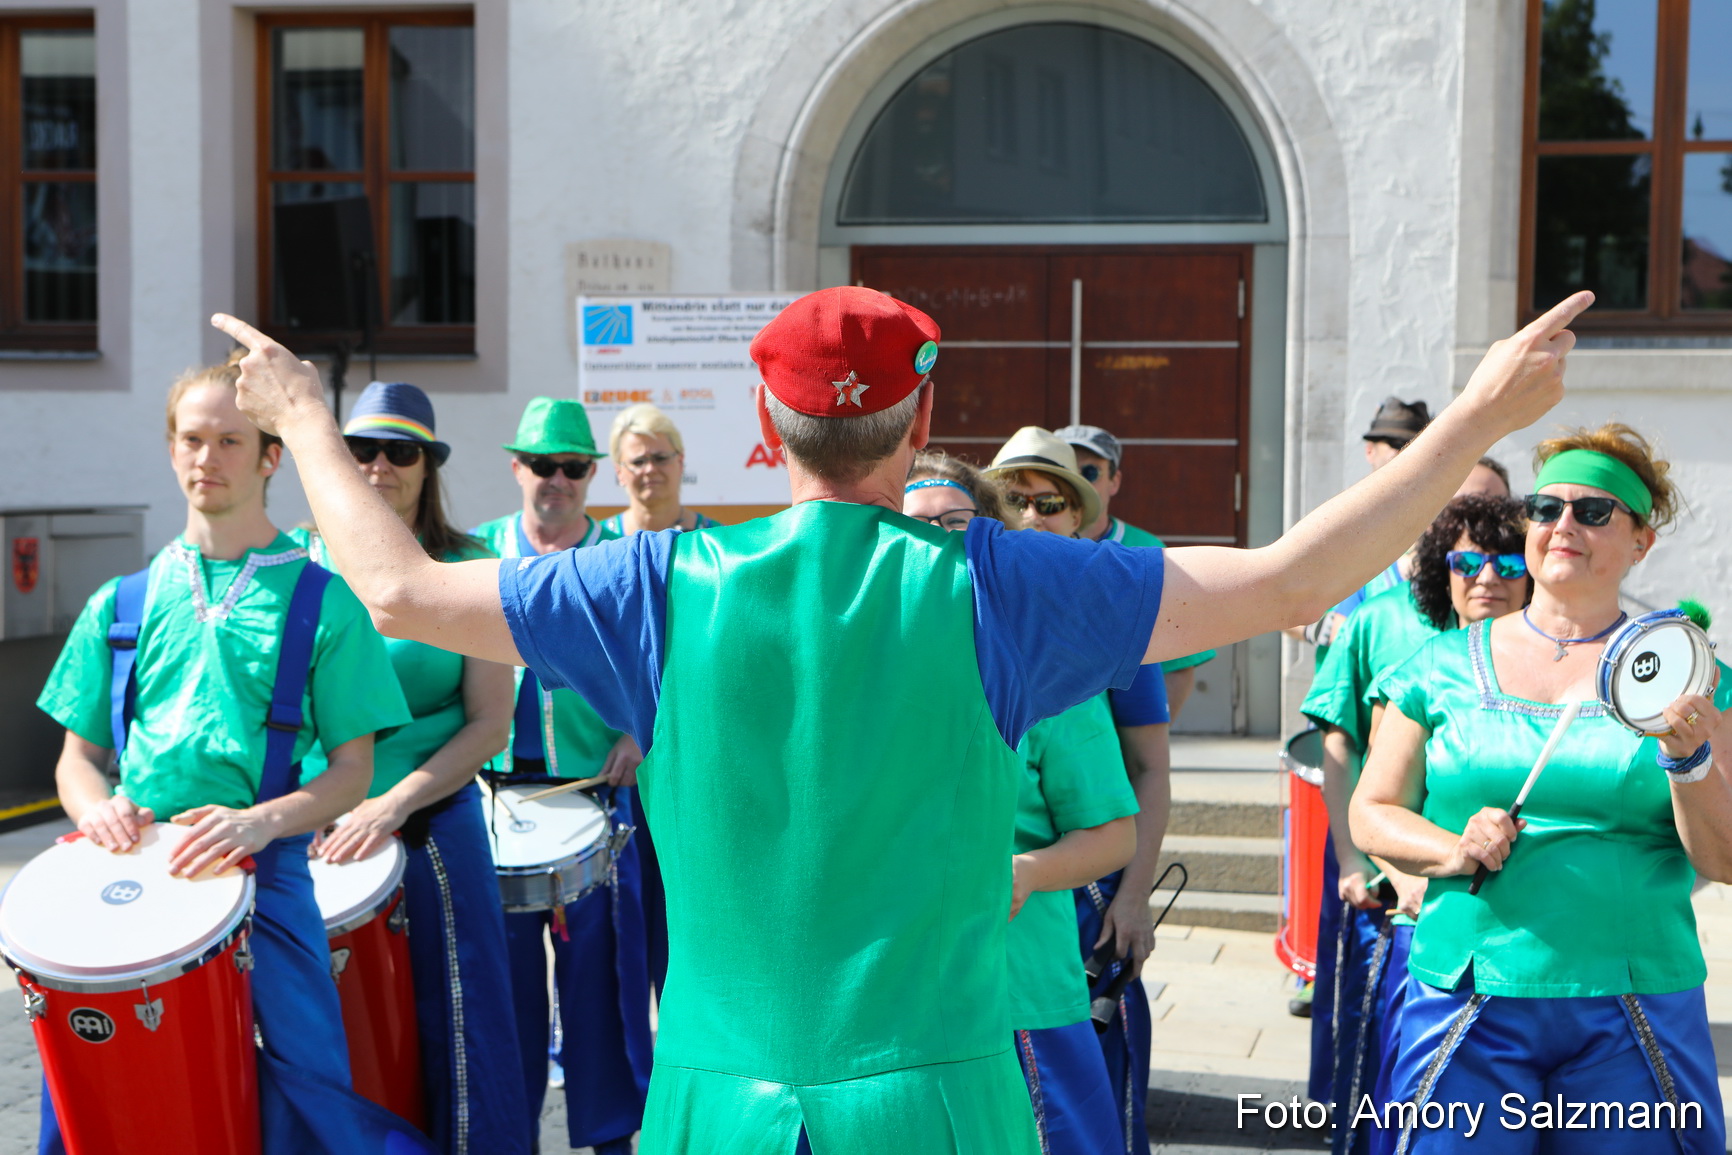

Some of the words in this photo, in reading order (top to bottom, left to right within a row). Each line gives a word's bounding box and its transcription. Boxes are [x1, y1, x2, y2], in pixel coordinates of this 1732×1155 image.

[642, 301, 708, 312] Mittendrin
[712, 301, 741, 312] statt
[746, 303, 765, 312] nur
